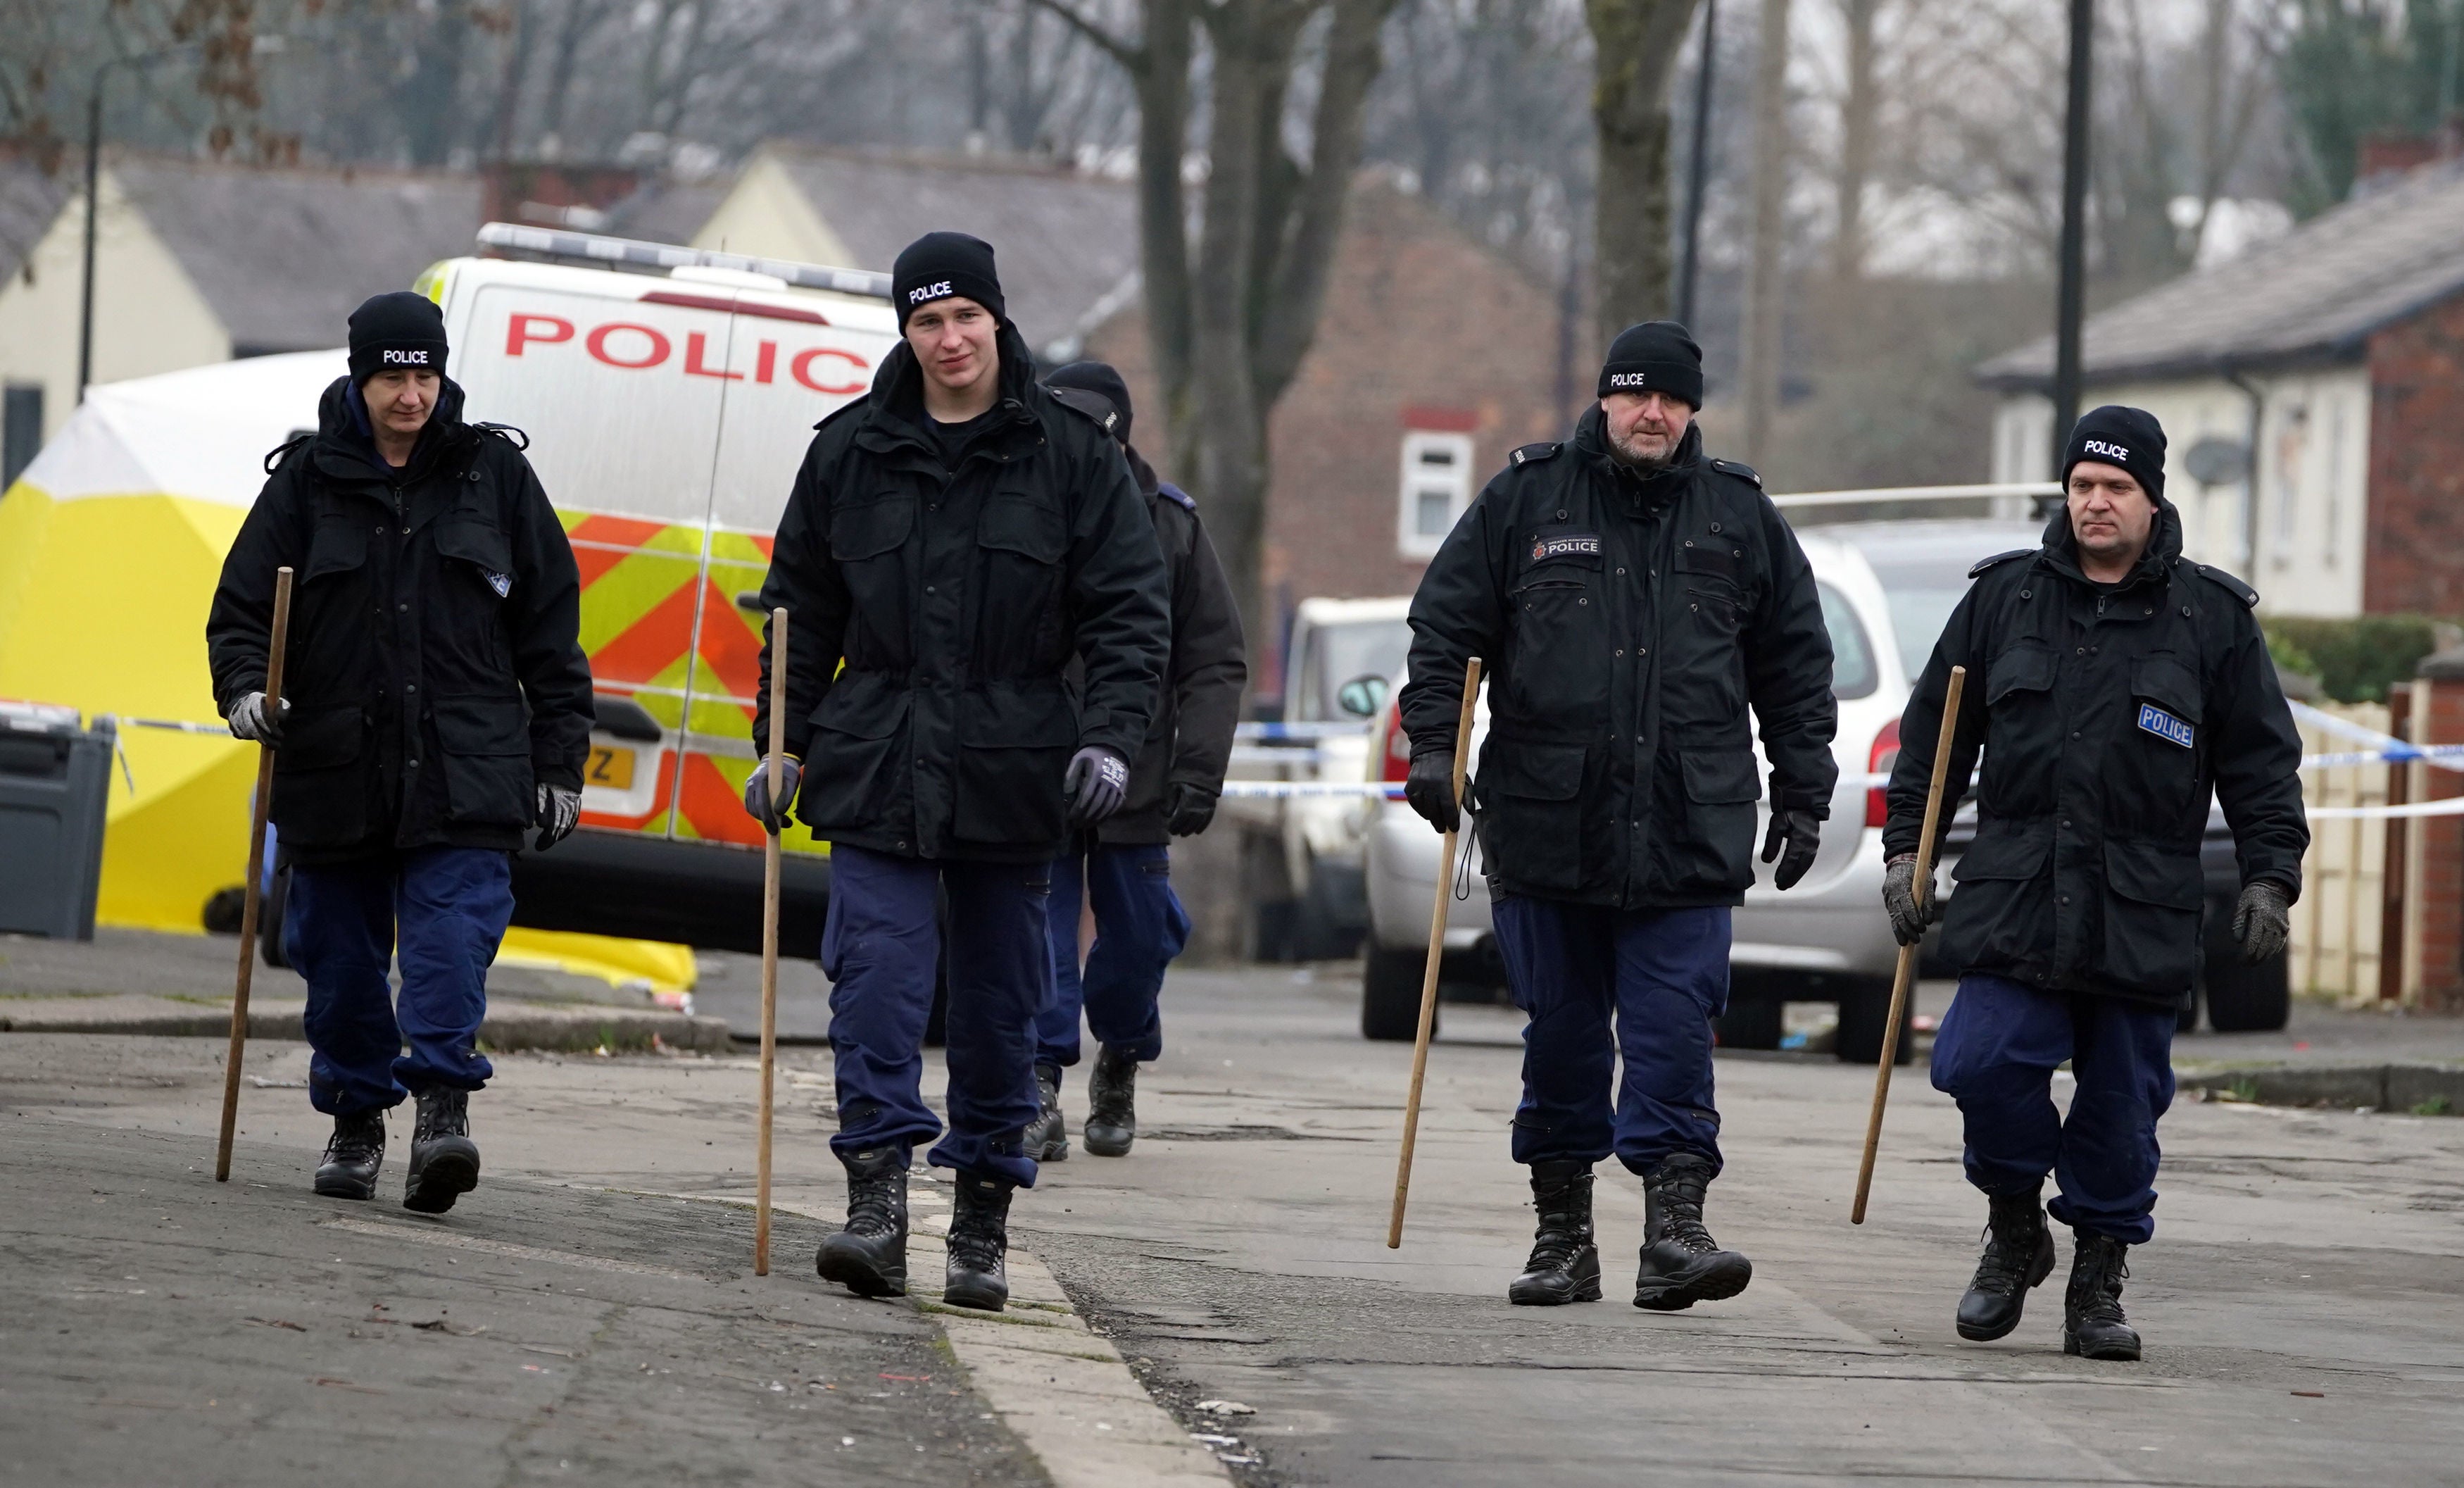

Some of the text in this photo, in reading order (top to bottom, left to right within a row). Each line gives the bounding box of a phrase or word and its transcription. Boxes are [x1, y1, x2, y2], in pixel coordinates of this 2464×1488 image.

[909, 280, 953, 304] POLICE
[384, 350, 428, 364] POLICE
[505, 311, 870, 395] POLIC
[1611, 373, 1645, 387] POLICE
[2085, 440, 2129, 461] POLICE
[1549, 542, 1598, 554] POLICE
[2142, 708, 2190, 744] POLICE
